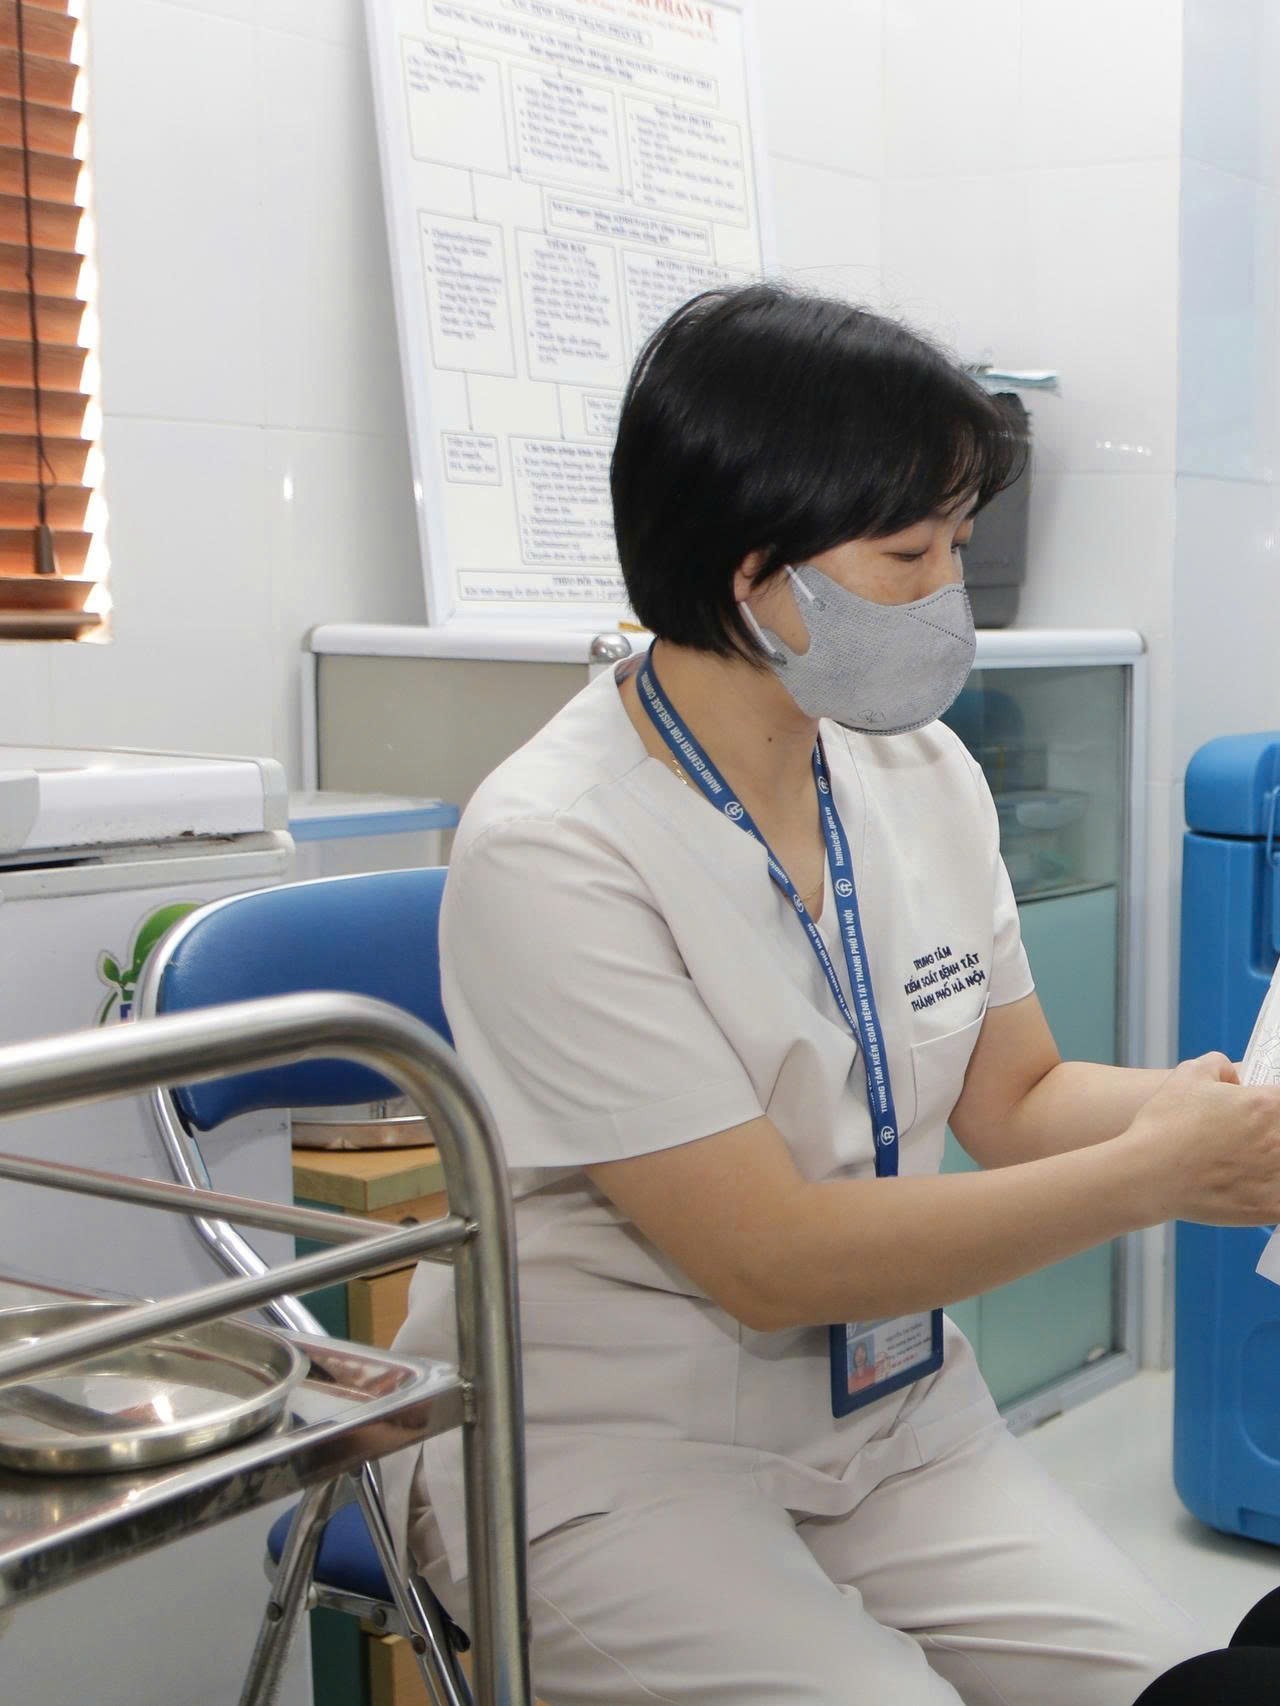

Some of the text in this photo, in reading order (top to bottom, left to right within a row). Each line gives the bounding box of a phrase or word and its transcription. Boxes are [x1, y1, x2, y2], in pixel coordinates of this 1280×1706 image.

[650, 697, 676, 729] DISEASE
[669, 726, 686, 744] FOR
[680, 741, 706, 772] CENTER
[700, 769, 722, 794] HANOI
[843, 909, 855, 924] NỘI
[845, 925, 856, 937] HÀ
[848, 937, 860, 955] PHỐ
[852, 955, 864, 982] THÀNH
[913, 946, 952, 971] TRUNG TÂM
[904, 953, 980, 996] KIỂM SOÁT BỆNH TẬT
[857, 983, 868, 998] TẬT
[911, 969, 986, 1012] THÀNH PHỐ HÀ NỘI
[860, 999, 873, 1021] BỆNH
[865, 1022, 877, 1043] SOÁT
[869, 1044, 881, 1066] KIỂM
[874, 1066, 884, 1085] TÂM
[878, 1085, 888, 1114] TRUNG
